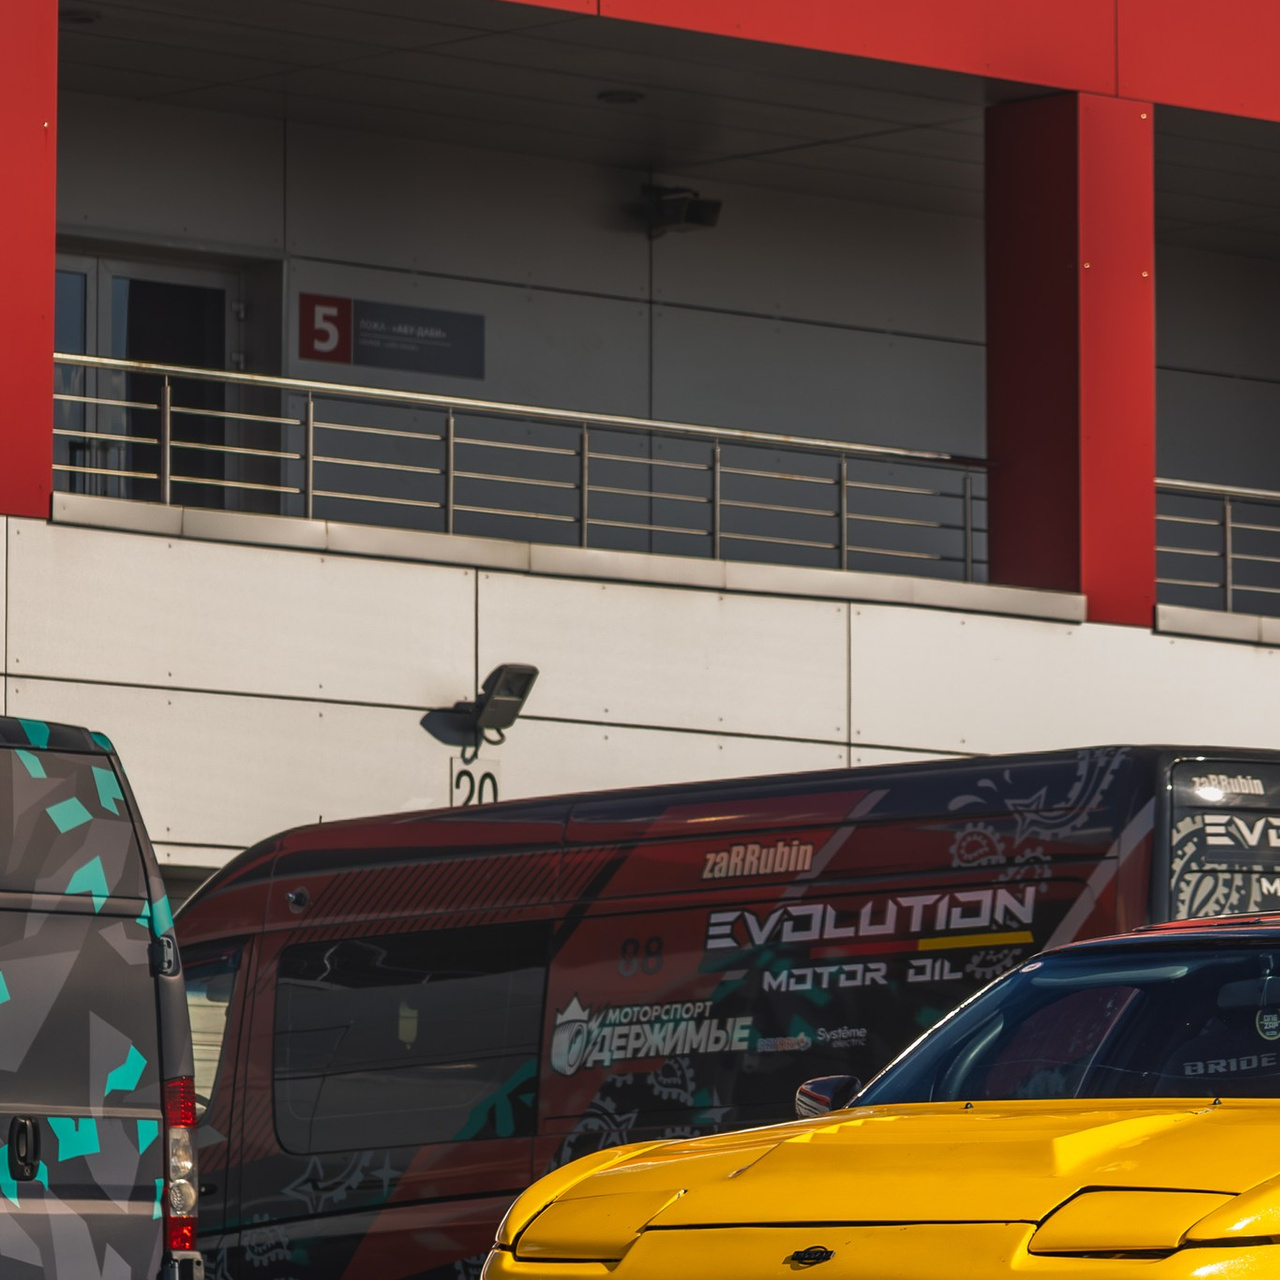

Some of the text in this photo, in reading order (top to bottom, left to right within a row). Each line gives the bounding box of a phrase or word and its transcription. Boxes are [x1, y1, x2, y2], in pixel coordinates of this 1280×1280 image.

[314, 306, 339, 352] 5
[705, 886, 1036, 951] EVOLUTION
[763, 958, 963, 993] MOTOR OIL
[606, 1000, 714, 1024] МОТОРСПОРТ
[1183, 1052, 1277, 1076] BRIDE
